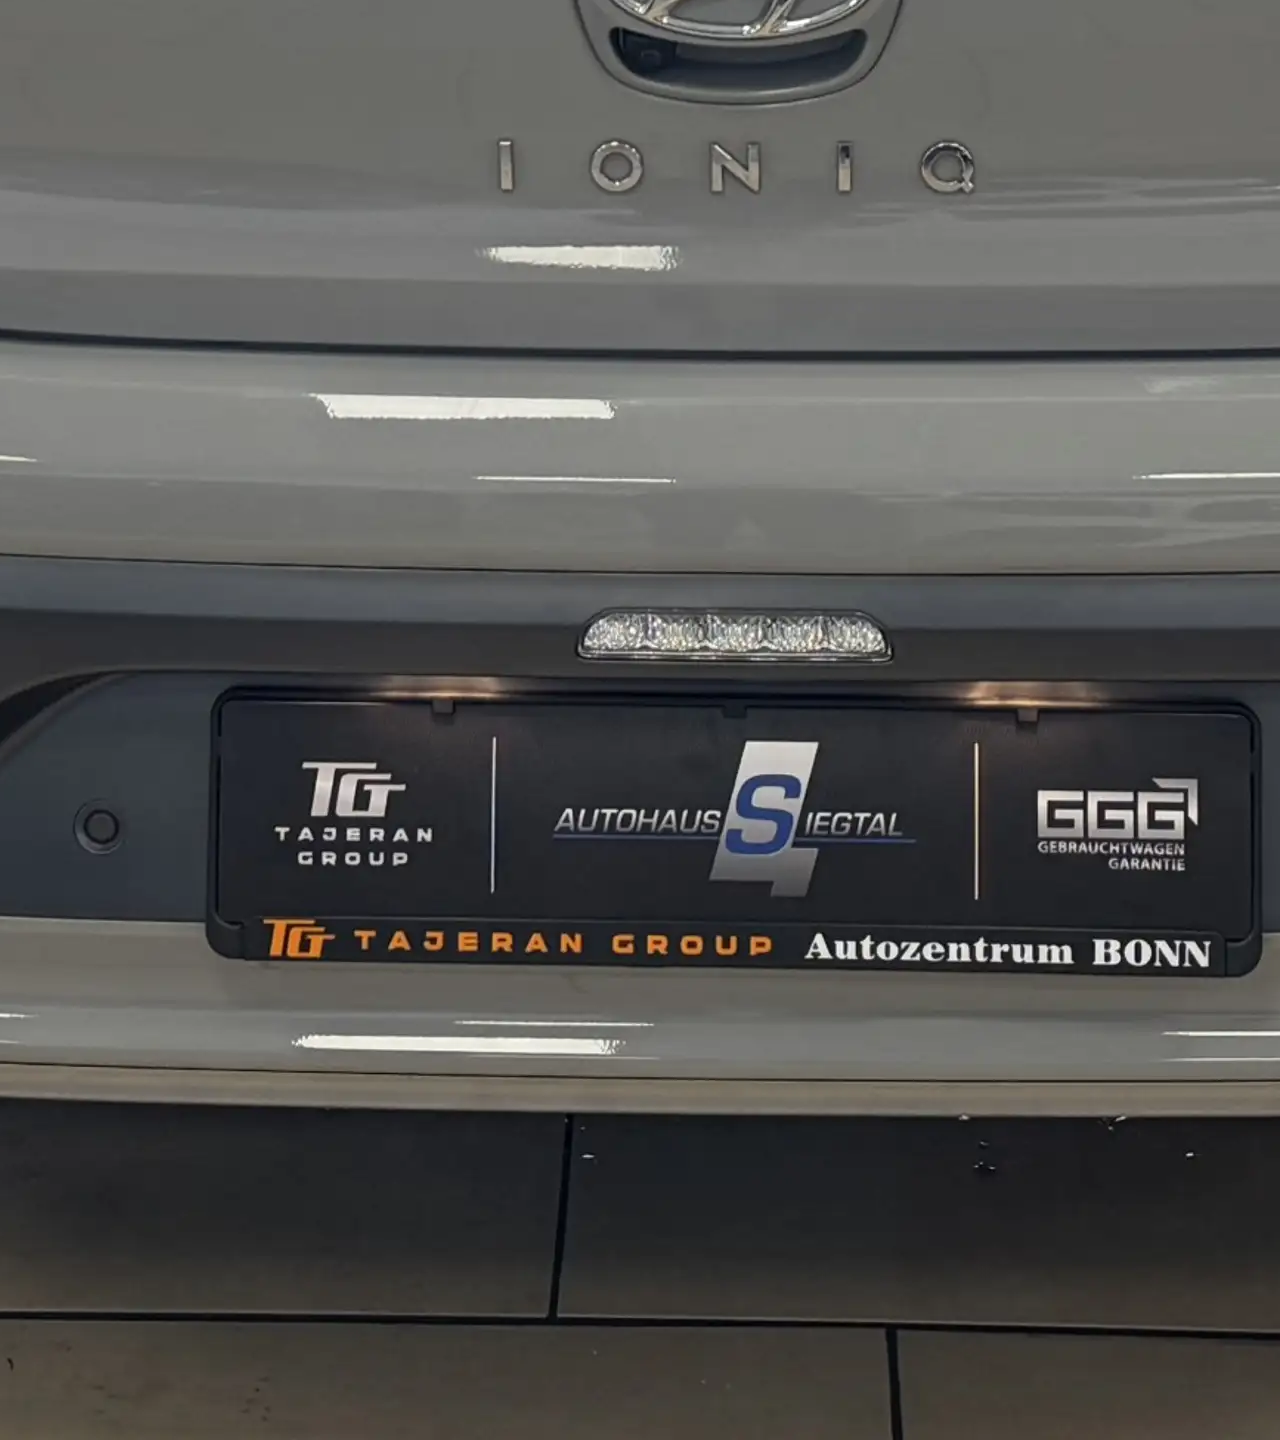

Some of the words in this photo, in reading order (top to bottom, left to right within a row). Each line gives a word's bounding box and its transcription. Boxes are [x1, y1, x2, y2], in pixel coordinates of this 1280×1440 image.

[498, 140, 975, 193] IONIQ
[554, 808, 722, 833] AUTOHAUS
[1037, 790, 1185, 839] GGG
[274, 826, 433, 842] TAJERAN
[1037, 840, 1185, 856] GEBRAUCHTWAGEN
[297, 851, 408, 866] GROUP
[1108, 857, 1186, 871] GARANTIE
[354, 929, 582, 953] TAJERAN
[611, 934, 773, 956] GROUP
[804, 932, 1075, 965] Autozentrum
[1091, 938, 1213, 968] BONN
